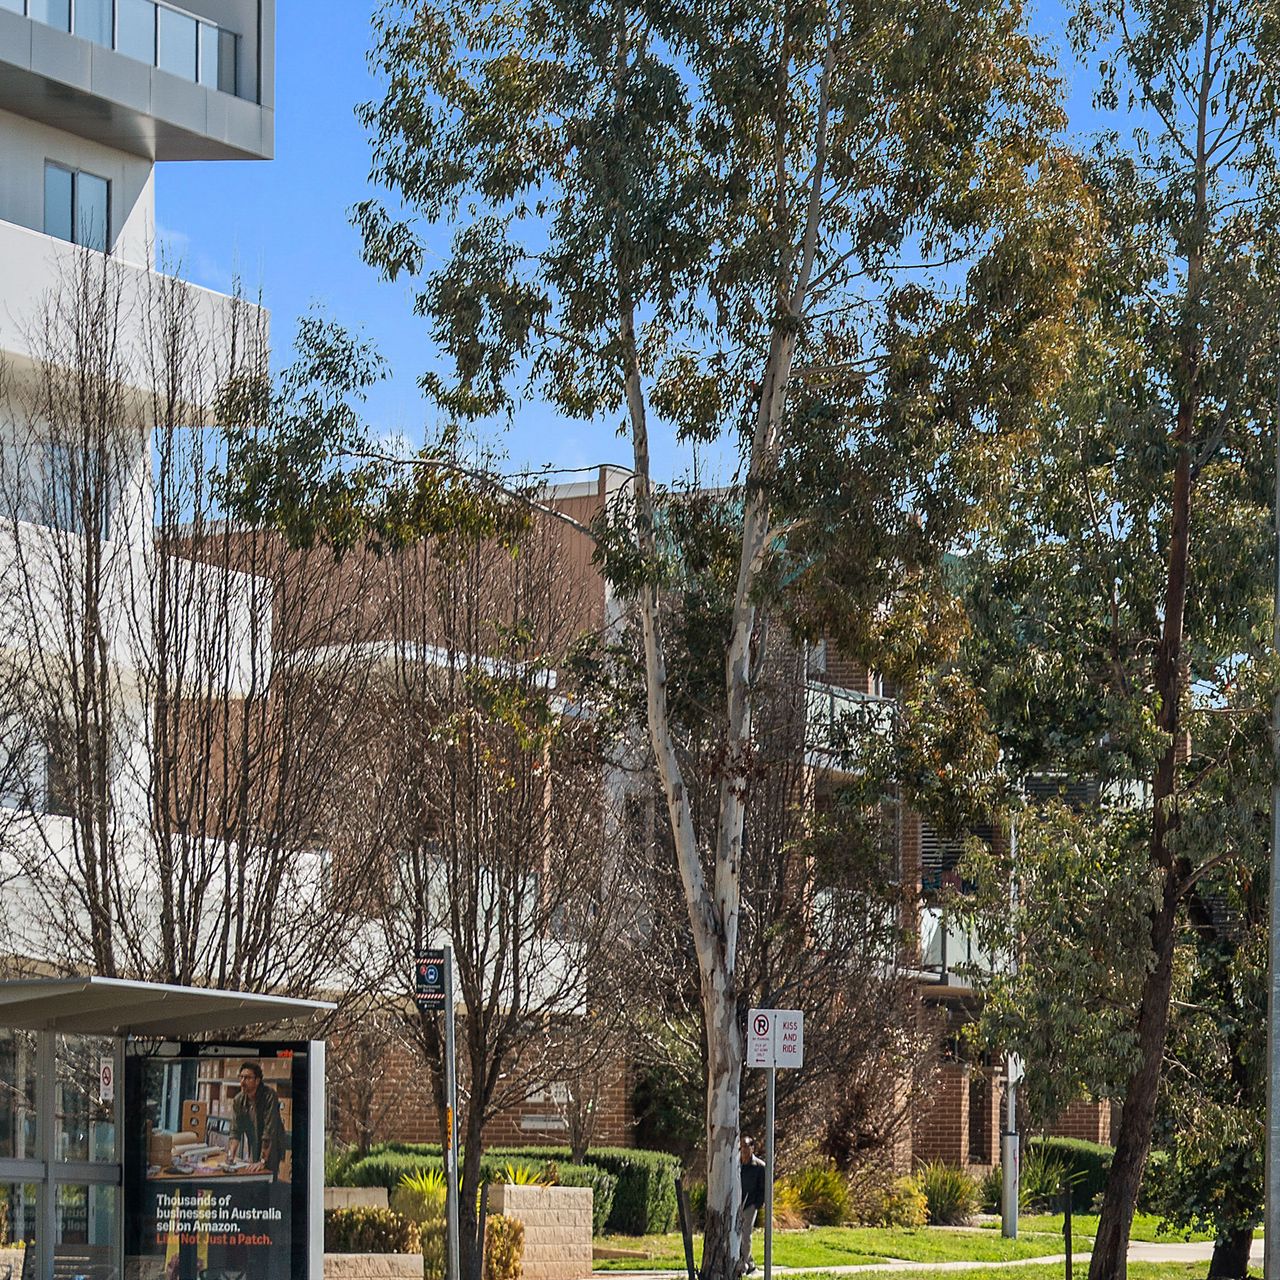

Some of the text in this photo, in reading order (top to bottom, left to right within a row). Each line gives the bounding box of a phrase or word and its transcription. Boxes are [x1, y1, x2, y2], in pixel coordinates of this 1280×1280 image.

[782, 1021, 798, 1031] KISS
[783, 1033, 798, 1042] AND
[782, 1044, 797, 1053] RIDE
[156, 1193, 232, 1206] Thousands of
[156, 1206, 282, 1219] businesses in Australia
[156, 1220, 241, 1232] sell on Amazon.
[181, 1233, 200, 1245] Not
[201, 1233, 227, 1245] Just
[229, 1235, 236, 1245] a
[238, 1233, 273, 1245] Patch.
